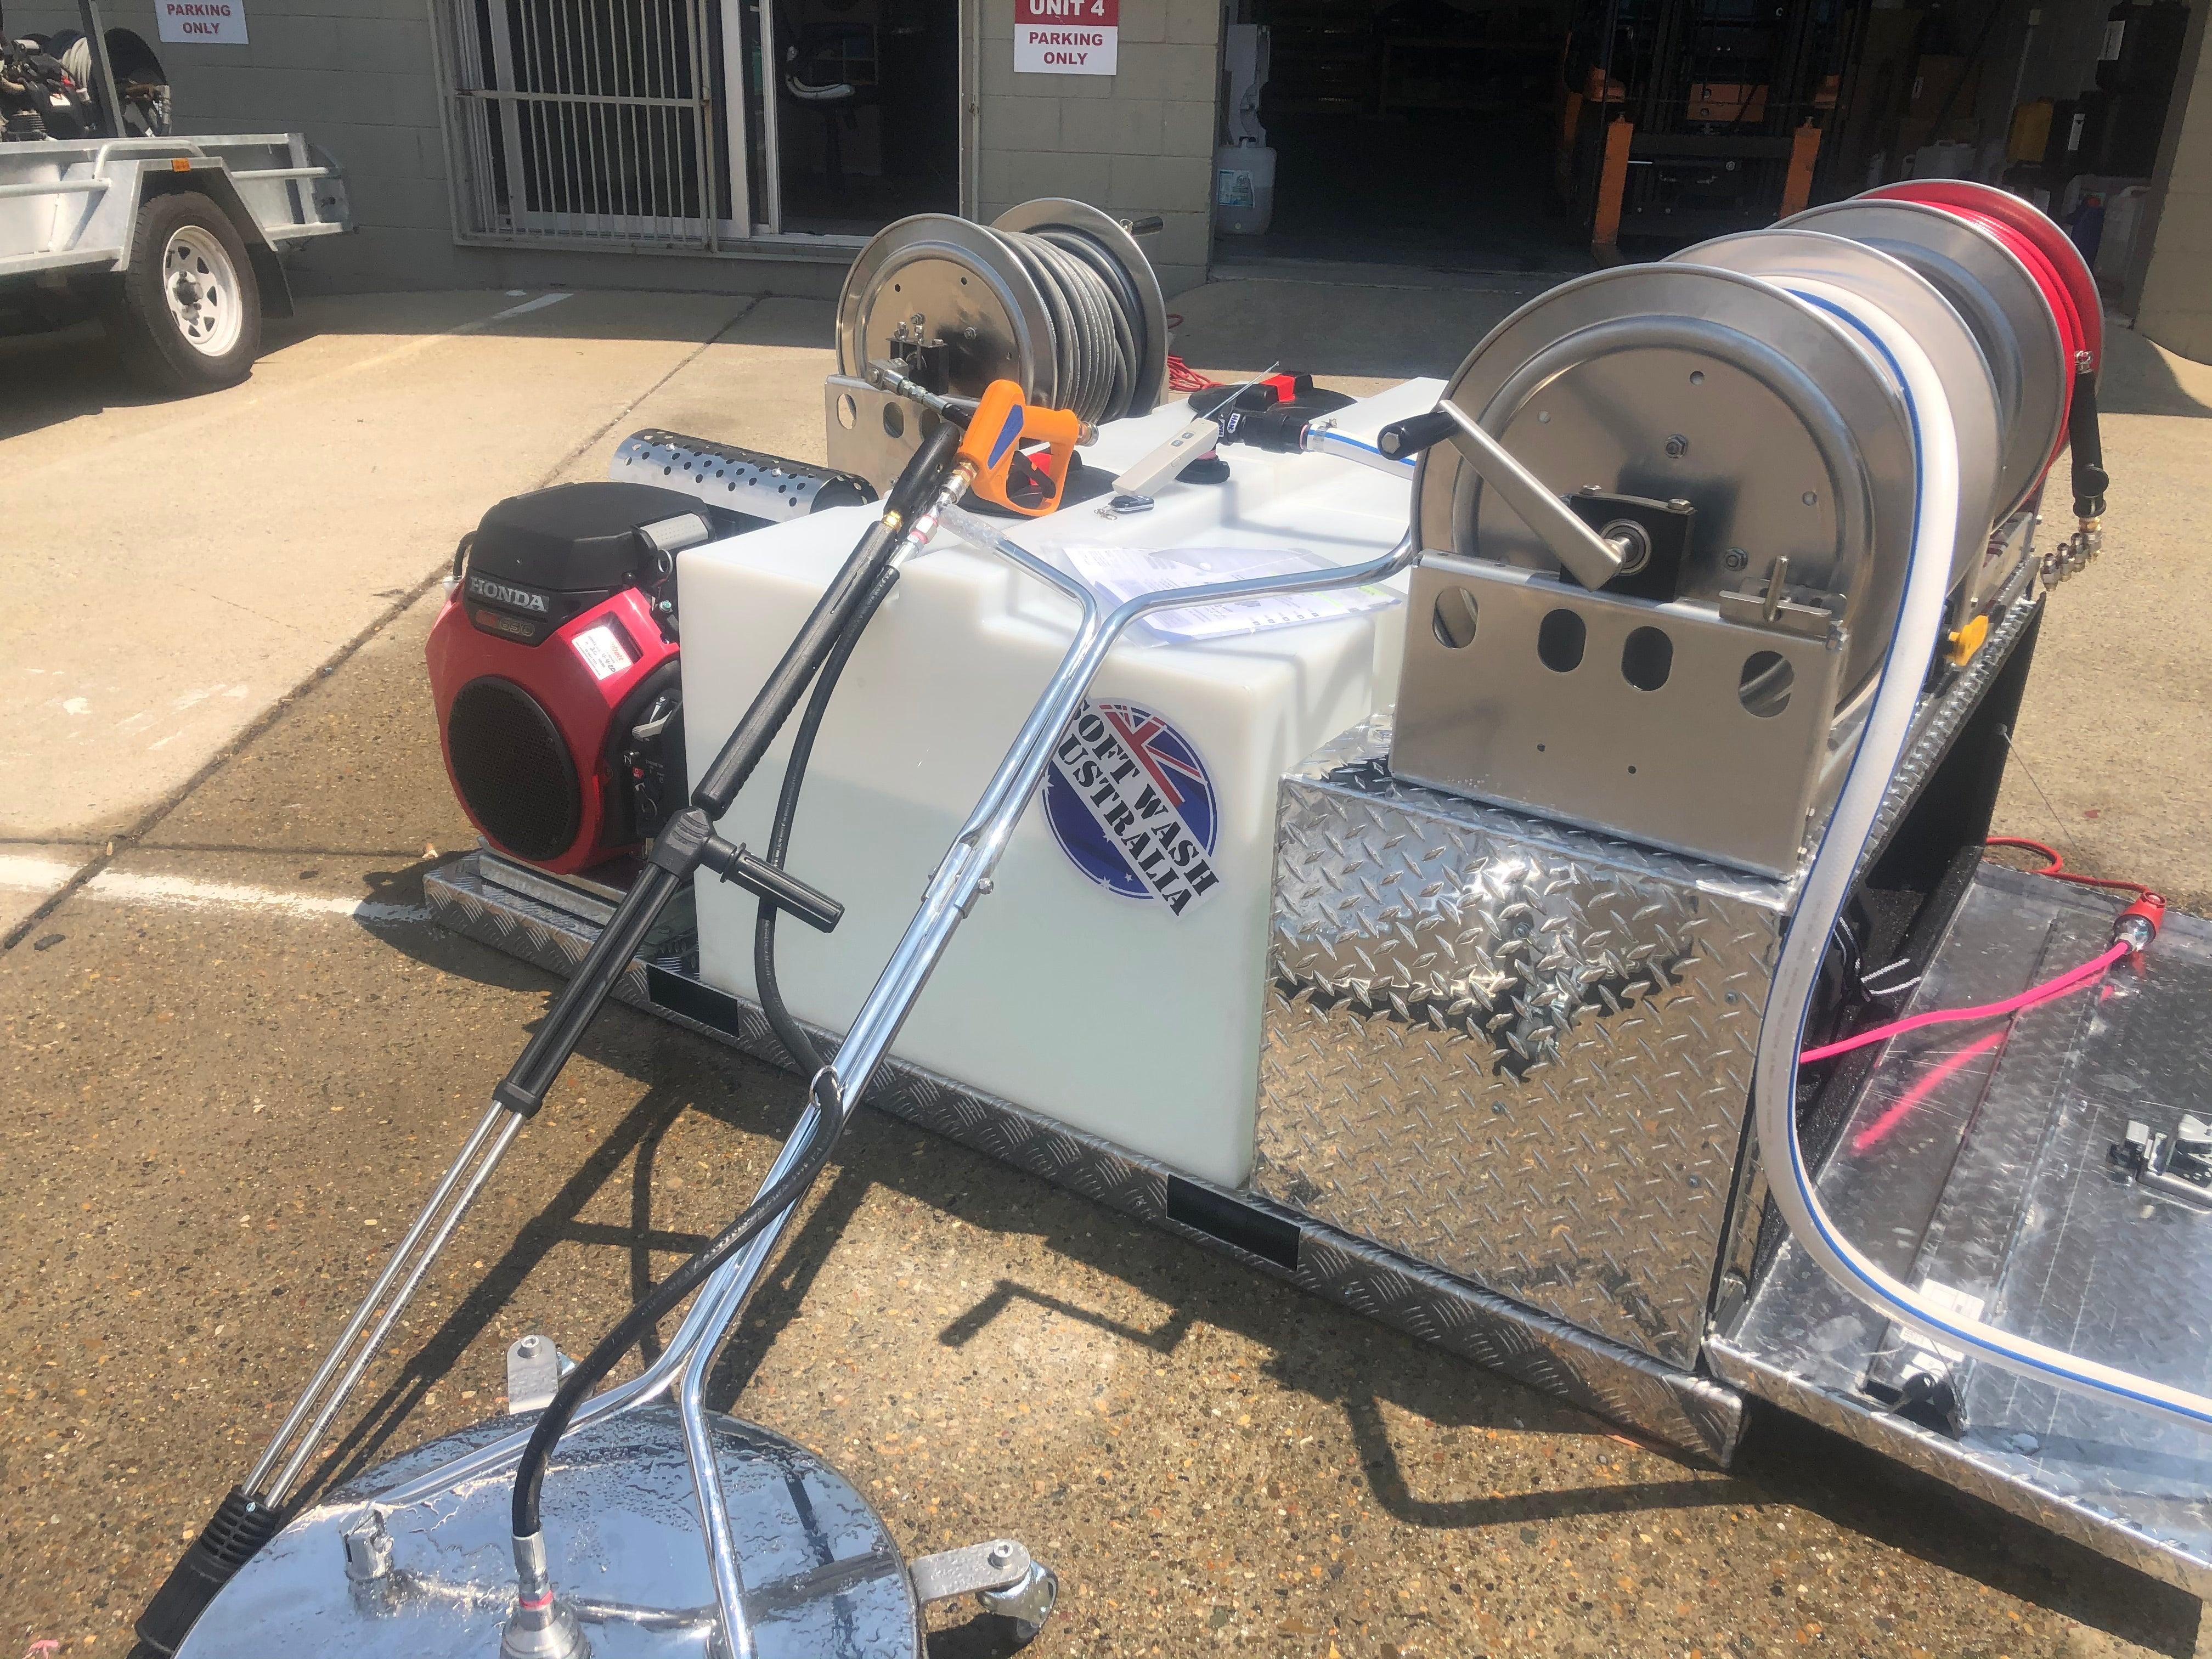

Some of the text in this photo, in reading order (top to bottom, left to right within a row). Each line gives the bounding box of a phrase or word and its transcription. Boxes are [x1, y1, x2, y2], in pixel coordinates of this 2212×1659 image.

[167, 3, 231, 16] PARKING
[1029, 0, 1105, 16] UNIT 4
[182, 22, 220, 35] ONLY
[1029, 32, 1103, 46] PARKING
[1043, 52, 1088, 65] ONLY
[470, 577, 547, 612] HONDA
[1058, 733, 1192, 916] USTRALIA
[1134, 783, 1220, 896] WASH
